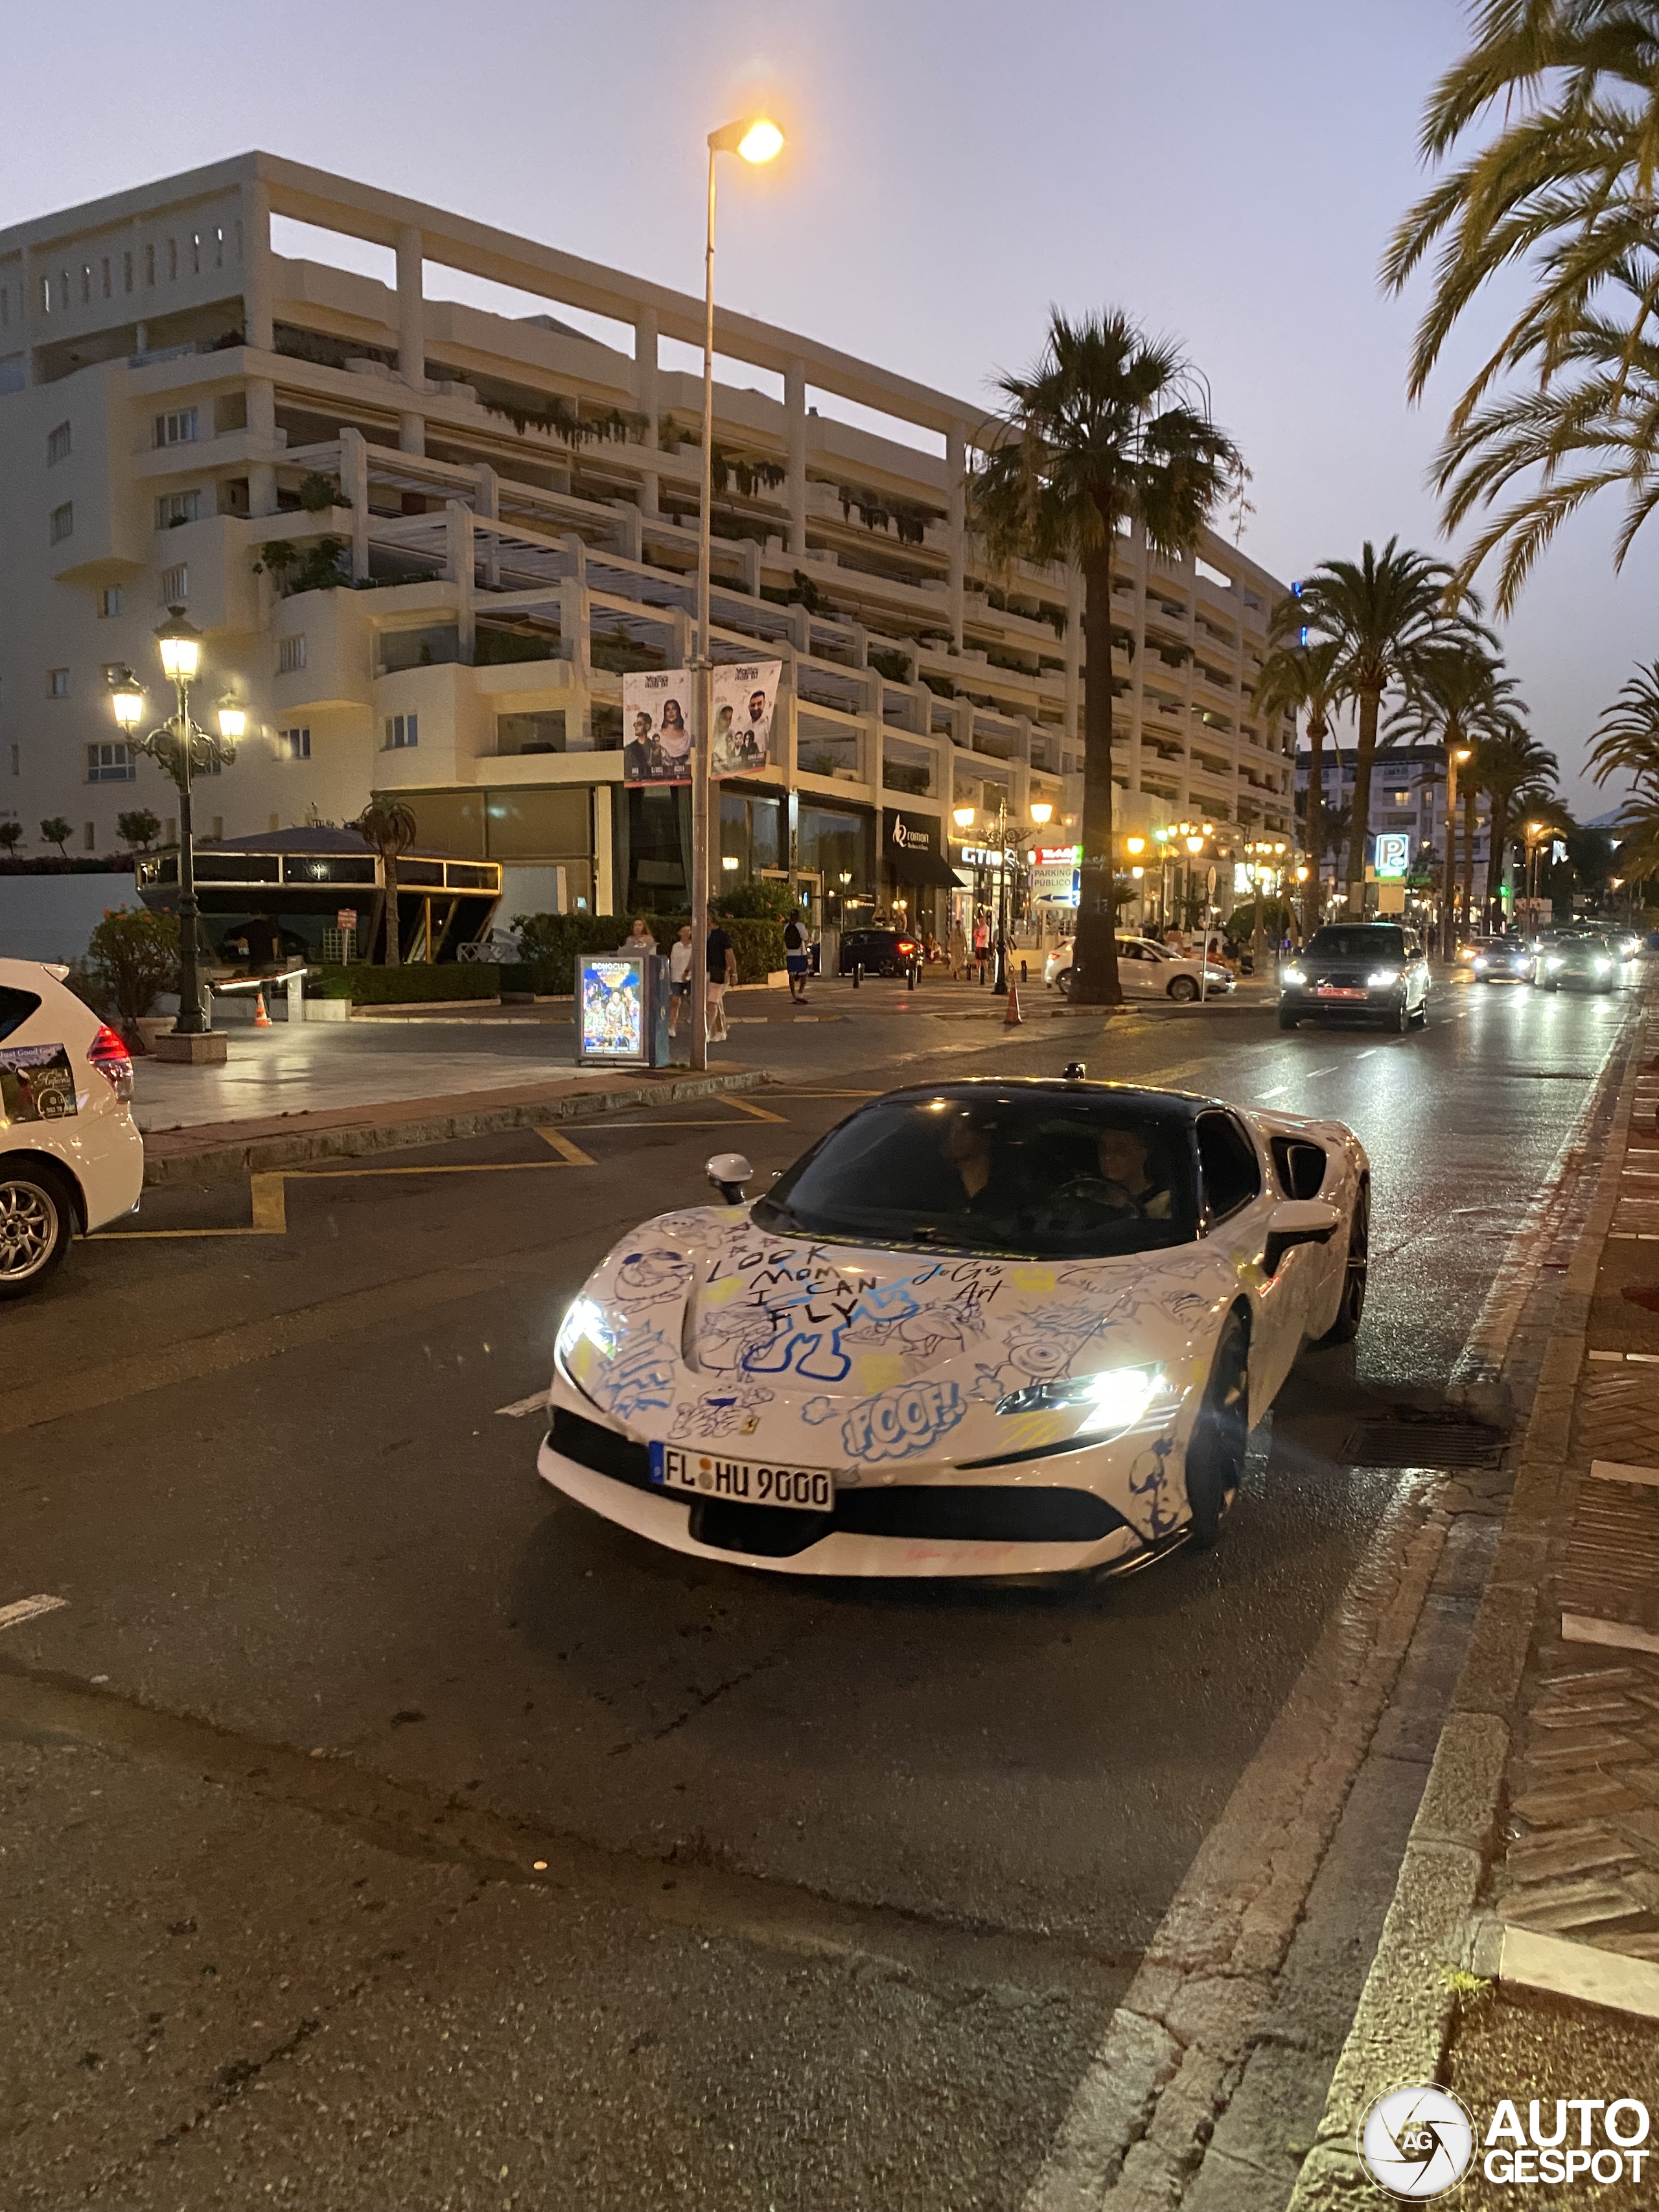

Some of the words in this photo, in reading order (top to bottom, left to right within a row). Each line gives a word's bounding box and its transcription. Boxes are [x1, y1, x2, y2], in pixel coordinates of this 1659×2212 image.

[907, 832, 929, 843] roman
[17, 1048, 38, 1056] Good
[706, 1245, 832, 1283] LOOK
[749, 1266, 841, 1289] MOM
[747, 1289, 771, 1307] I
[806, 1277, 877, 1296] CAN
[954, 1280, 1011, 1304] Art
[768, 1298, 859, 1332] FLY
[666, 1450, 695, 1486] FL
[715, 1461, 748, 1497] HU
[758, 1468, 828, 1504] 9000
